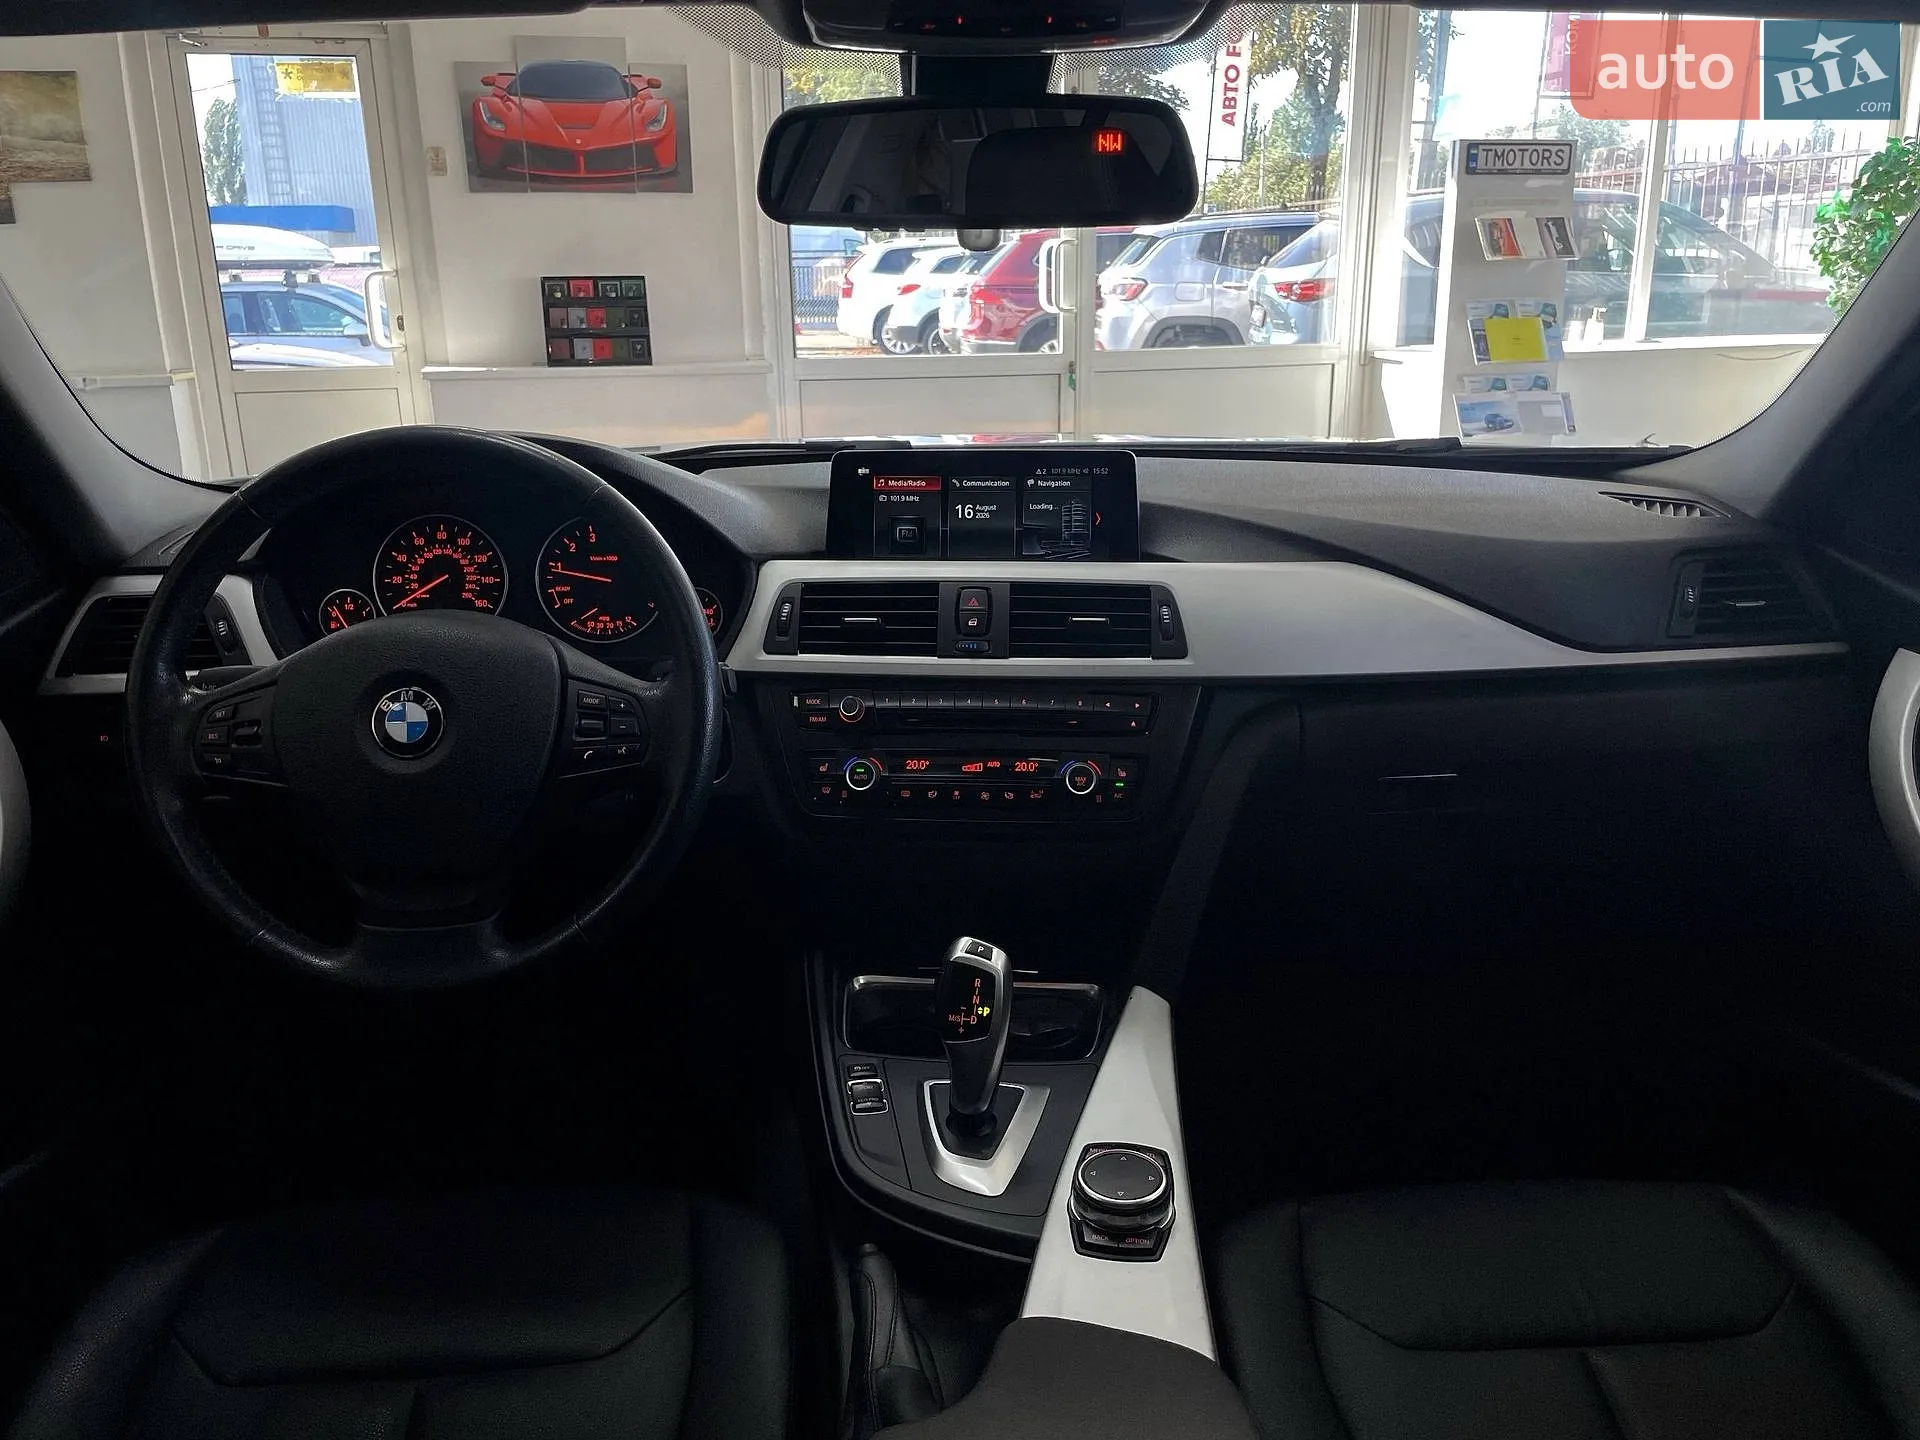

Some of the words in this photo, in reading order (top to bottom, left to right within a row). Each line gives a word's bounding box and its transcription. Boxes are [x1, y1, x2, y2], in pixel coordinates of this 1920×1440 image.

[1221, 64, 1241, 126] АВТО
[1098, 134, 1122, 152] NW
[1481, 148, 1565, 167] TMOTORS
[962, 480, 1010, 488] Communication
[1037, 480, 1071, 488] Navigation
[955, 504, 974, 519] 16
[975, 504, 997, 512] August
[437, 531, 447, 540] 80
[589, 533, 596, 543] 3
[414, 538, 425, 546] 60
[457, 538, 470, 546] 100
[569, 543, 576, 552] 2
[397, 554, 407, 562] 40
[474, 554, 487, 563] 120
[556, 562, 562, 571] 1
[392, 576, 402, 584] 20
[481, 576, 494, 584] 140
[474, 600, 488, 608] 160
[380, 690, 436, 713] BMW
[977, 945, 985, 953] P
[974, 978, 981, 988] R
[972, 994, 980, 1005] N
[983, 1006, 991, 1017] P
[970, 1015, 978, 1025] D
